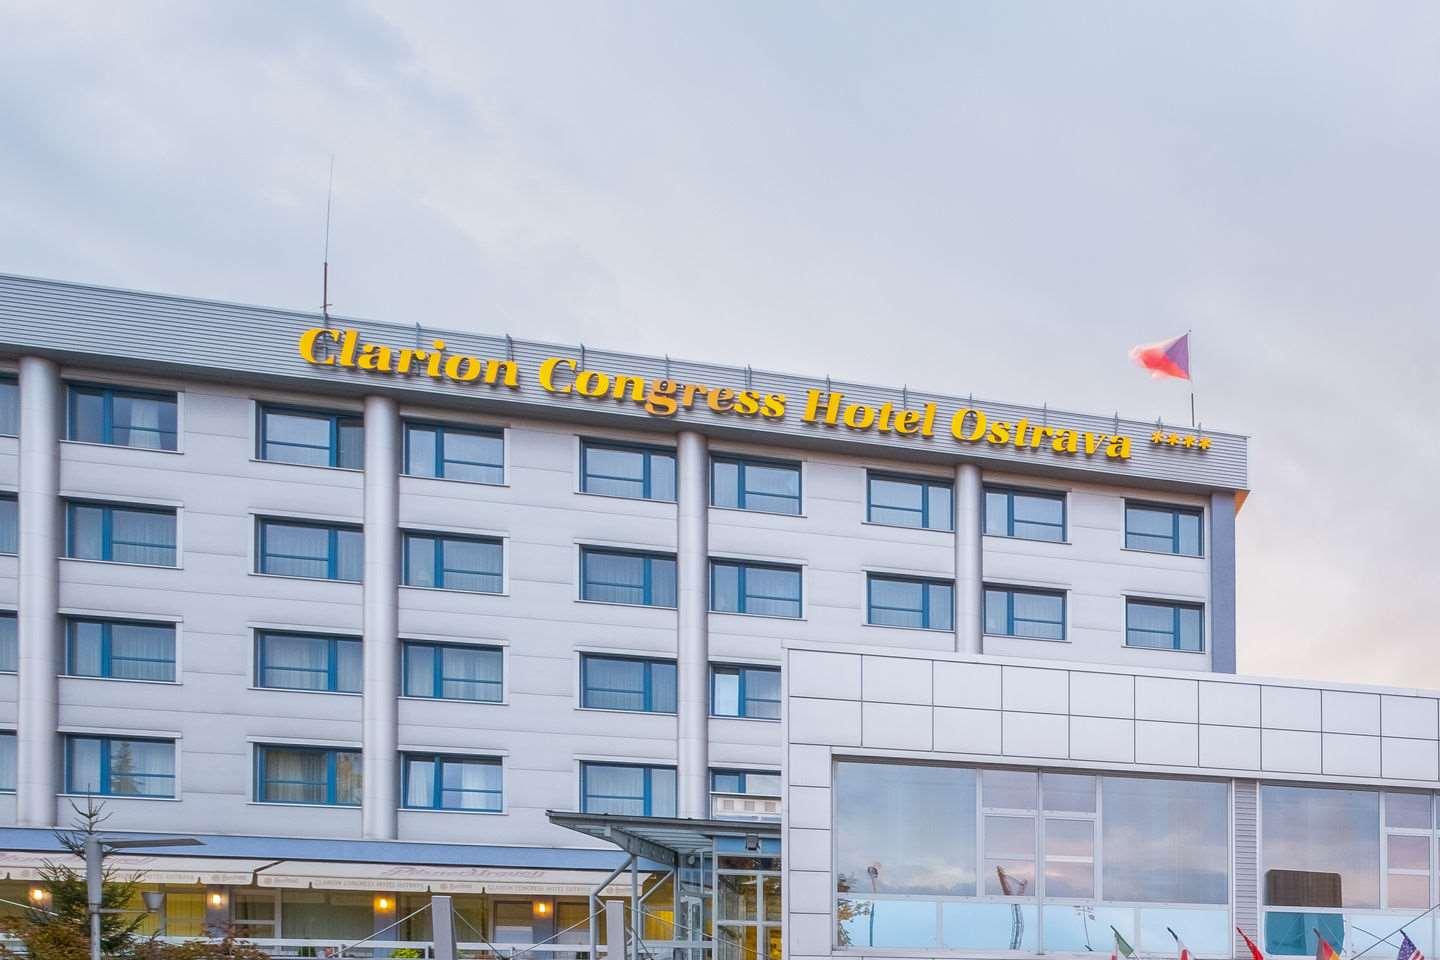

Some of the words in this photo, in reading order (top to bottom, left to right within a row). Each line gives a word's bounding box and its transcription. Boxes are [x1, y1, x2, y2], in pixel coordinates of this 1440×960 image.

[298, 327, 519, 389] Clarion
[538, 356, 786, 418] Congress
[803, 387, 937, 438] Hotel
[950, 407, 1132, 461] Ostrava
